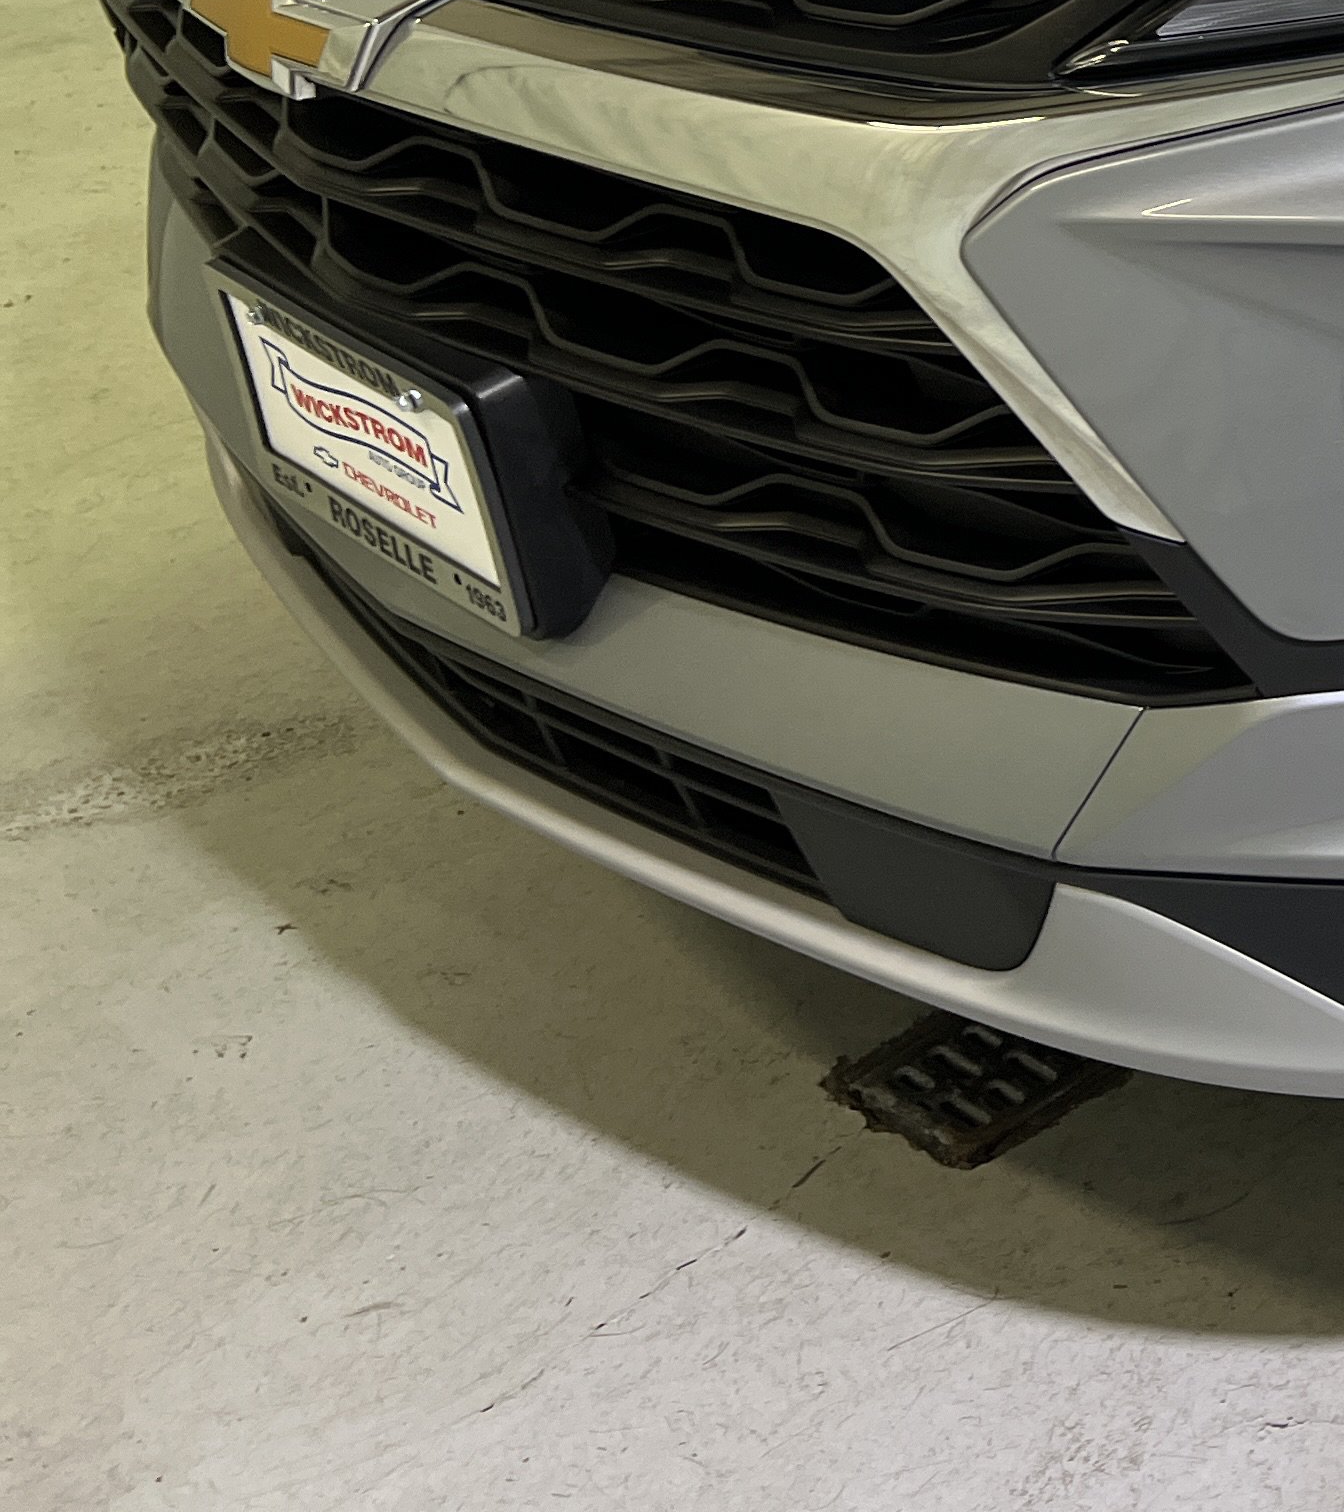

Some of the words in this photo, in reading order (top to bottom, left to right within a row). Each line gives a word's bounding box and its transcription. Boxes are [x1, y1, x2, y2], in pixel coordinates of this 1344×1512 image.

[256, 298, 401, 399] WICKSTROM
[290, 383, 429, 467] WICKSTROM
[342, 461, 438, 529] CHEVROLET
[327, 494, 438, 585] ROSELLE
